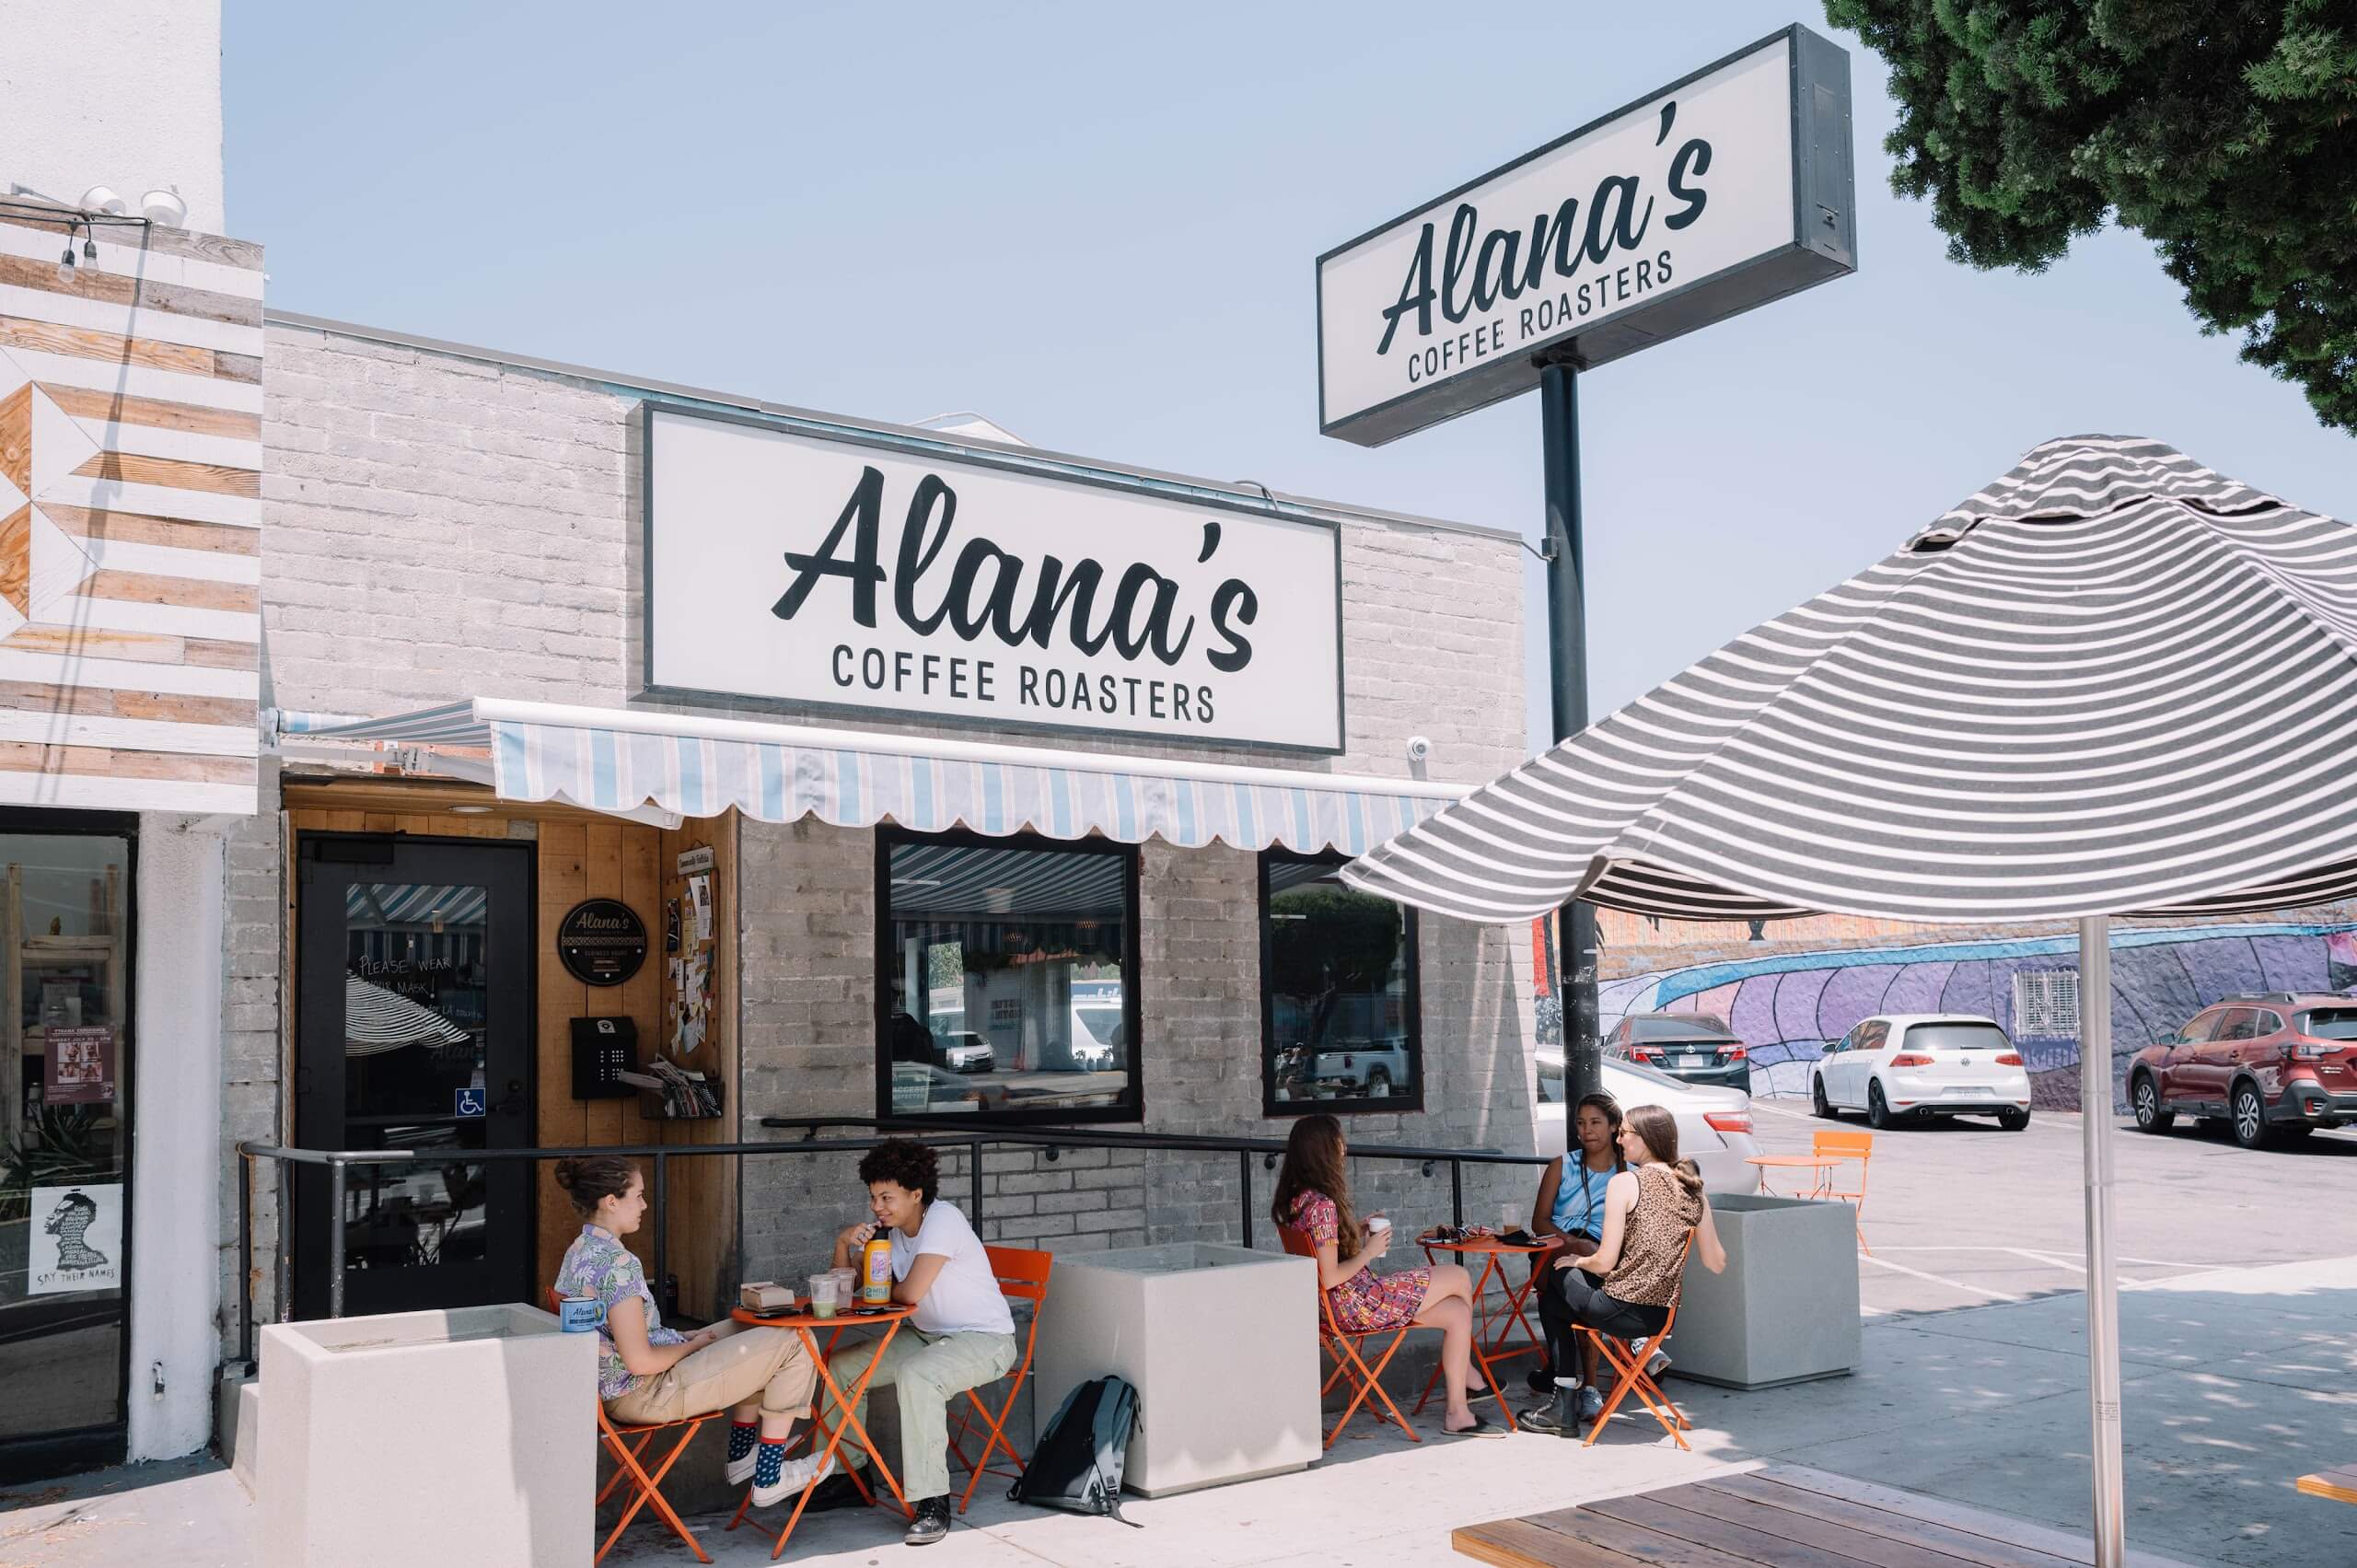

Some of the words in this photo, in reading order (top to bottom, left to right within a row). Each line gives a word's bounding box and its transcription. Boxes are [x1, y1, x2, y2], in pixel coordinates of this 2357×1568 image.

[1376, 100, 1713, 355] Alana's
[1409, 319, 1504, 383] COFFEE
[1520, 250, 1673, 340] ROASTERS
[771, 465, 1259, 673] Alana's
[832, 645, 995, 702] COFFEE
[1020, 666, 1214, 724] ROASTERS
[575, 912, 630, 929] Alana's
[359, 955, 408, 976] PLEASE
[418, 957, 451, 972] WEAR
[37, 1272, 56, 1286] SAY
[60, 1272, 86, 1283] THEIR
[89, 1269, 115, 1280] NAMES
